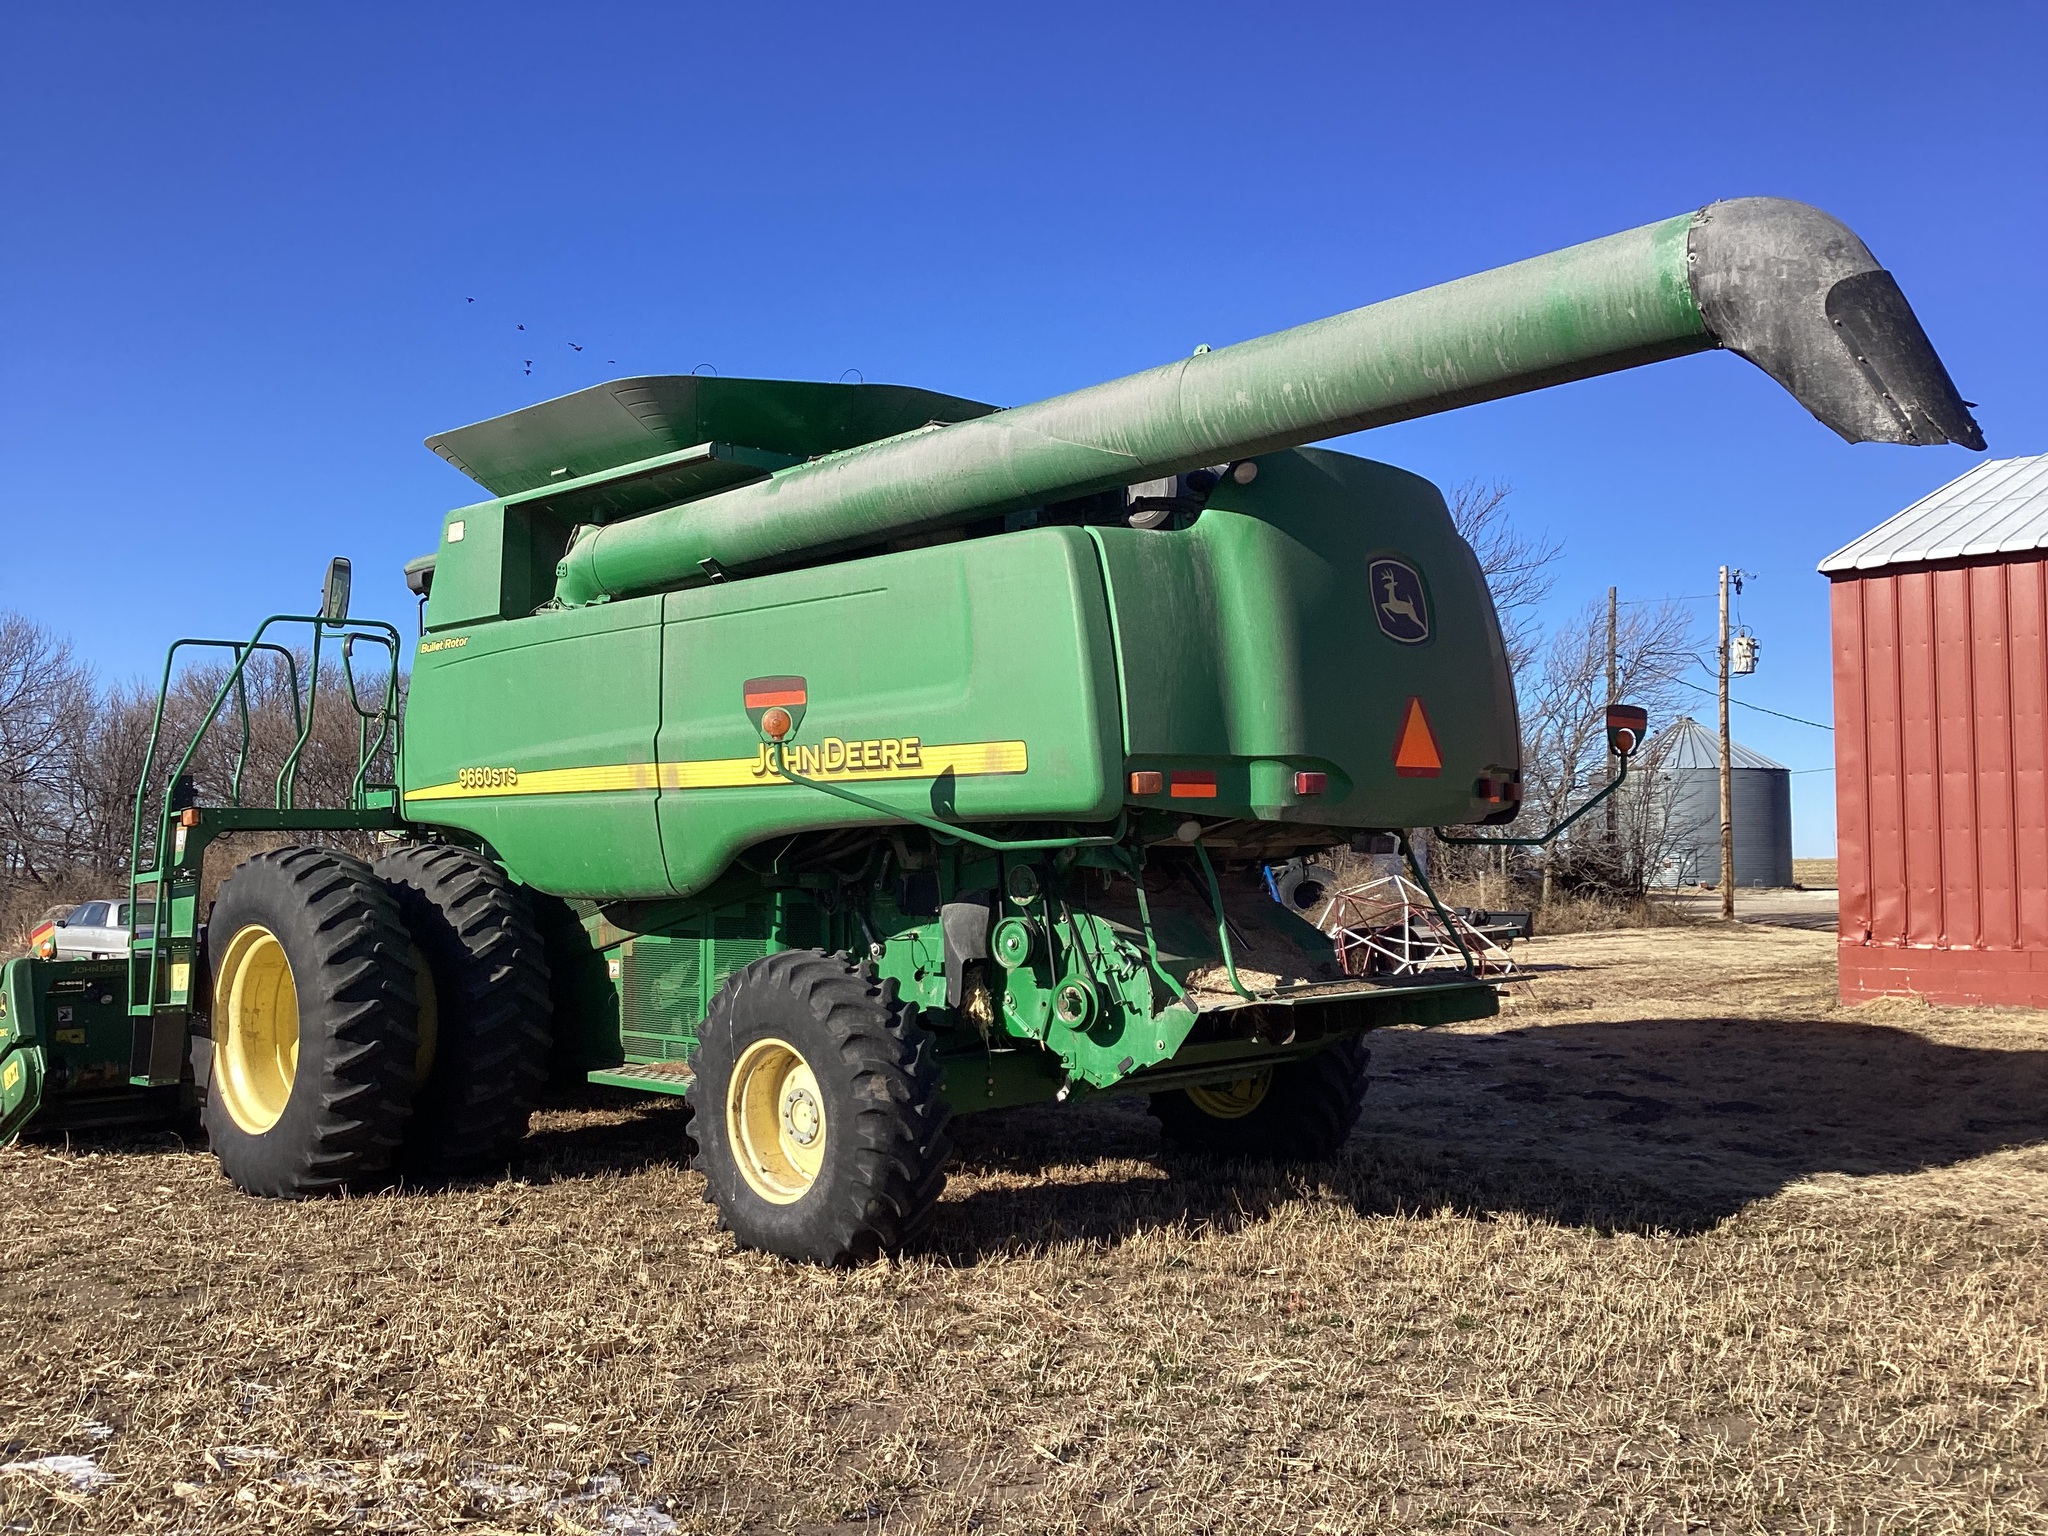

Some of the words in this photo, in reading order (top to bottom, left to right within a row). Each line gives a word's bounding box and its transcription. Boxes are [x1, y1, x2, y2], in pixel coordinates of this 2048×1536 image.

[420, 640, 444, 654] Bullet
[445, 637, 469, 649] Rotor
[823, 737, 922, 773] DEERE
[459, 767, 518, 788] 9660STS
[71, 965, 99, 974] JOHN
[100, 963, 129, 973] DEER
